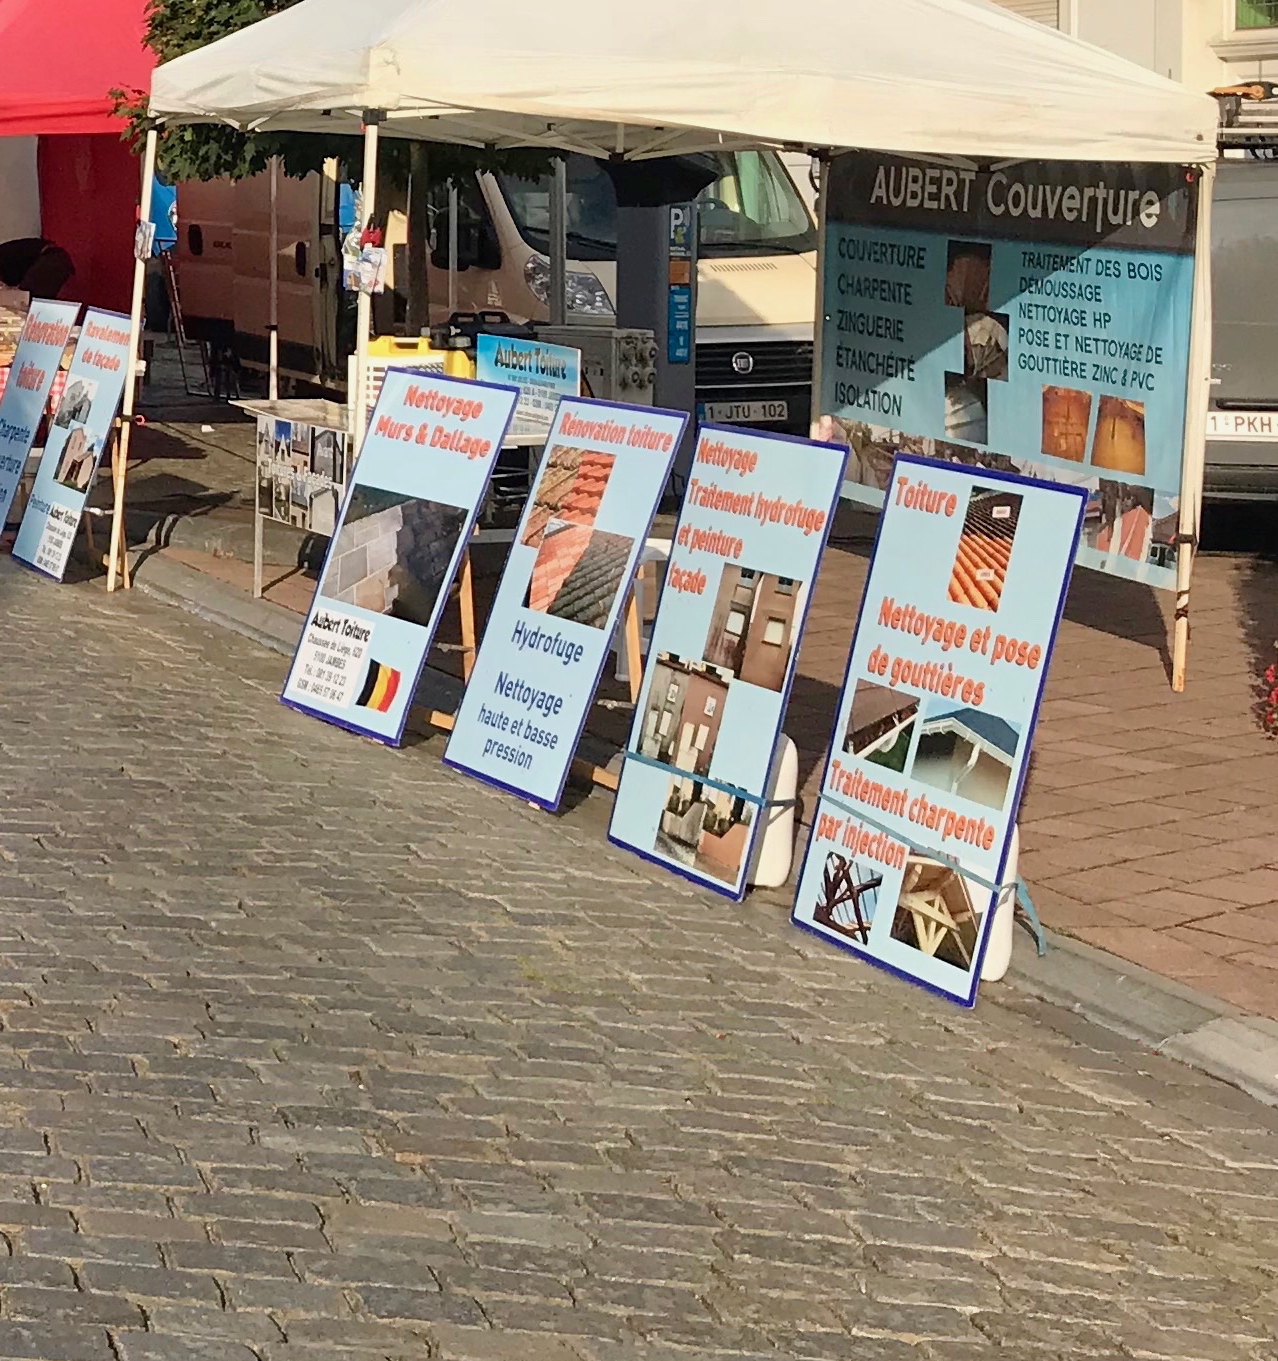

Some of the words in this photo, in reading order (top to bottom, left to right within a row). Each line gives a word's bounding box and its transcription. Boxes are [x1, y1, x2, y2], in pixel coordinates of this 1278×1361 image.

[870, 165, 976, 213] AUBERT
[986, 171, 1160, 233] Couverture
[838, 237, 927, 270] COUVERTURE
[1022, 251, 1091, 275] TRAITEMENT
[1096, 259, 1121, 278] DES
[1127, 262, 1163, 281] BOIS
[837, 272, 912, 305] CHARPENTE
[85, 320, 132, 346] Ravalemen
[837, 309, 904, 342] ZINGUERIE
[1019, 302, 1087, 327] NETTOYAGE
[1093, 311, 1111, 329] HP
[494, 341, 533, 372] Aubert
[534, 348, 567, 380] Toiture
[835, 340, 915, 382] ÉTANCHÉITÉ
[1018, 327, 1050, 348] POSE
[1055, 332, 1070, 351] ET
[1075, 336, 1143, 362] NETTOYAGE
[1145, 345, 1163, 365] DE
[1018, 353, 1087, 379] GOUTTIÈRE
[1092, 363, 1118, 385] ZINC
[1121, 369, 1127, 387] &
[1130, 371, 1154, 391] PVC
[403, 384, 483, 421] Nettoyage
[834, 380, 902, 418] ISOLATION
[374, 414, 414, 441] Murs
[415, 422, 428, 445] &
[429, 424, 491, 460] Dallage
[558, 411, 627, 445] Rénovation
[627, 424, 673, 453] toiture
[696, 436, 758, 477] Nettoyage
[687, 478, 755, 517] Traitement
[753, 491, 826, 536] hydrofuge
[895, 476, 958, 517] Toiture
[677, 522, 692, 546] et
[688, 525, 743, 559] peinture
[667, 559, 707, 595] façade
[311, 611, 342, 633] Aubert
[340, 618, 371, 642] Toiture
[511, 619, 584, 665] Hydrofuge
[877, 595, 967, 651] Nettoyage
[969, 625, 991, 656] et
[990, 633, 1041, 670] pose
[867, 643, 890, 676] de
[494, 670, 563, 717] Nettoyage
[477, 703, 509, 731] haute
[510, 716, 523, 737] et
[523, 719, 559, 750] basse
[482, 737, 533, 770] pression
[829, 758, 909, 818] Traitement
[908, 793, 995, 851] charpente
[816, 812, 843, 842] par
[842, 816, 906, 870] injection
